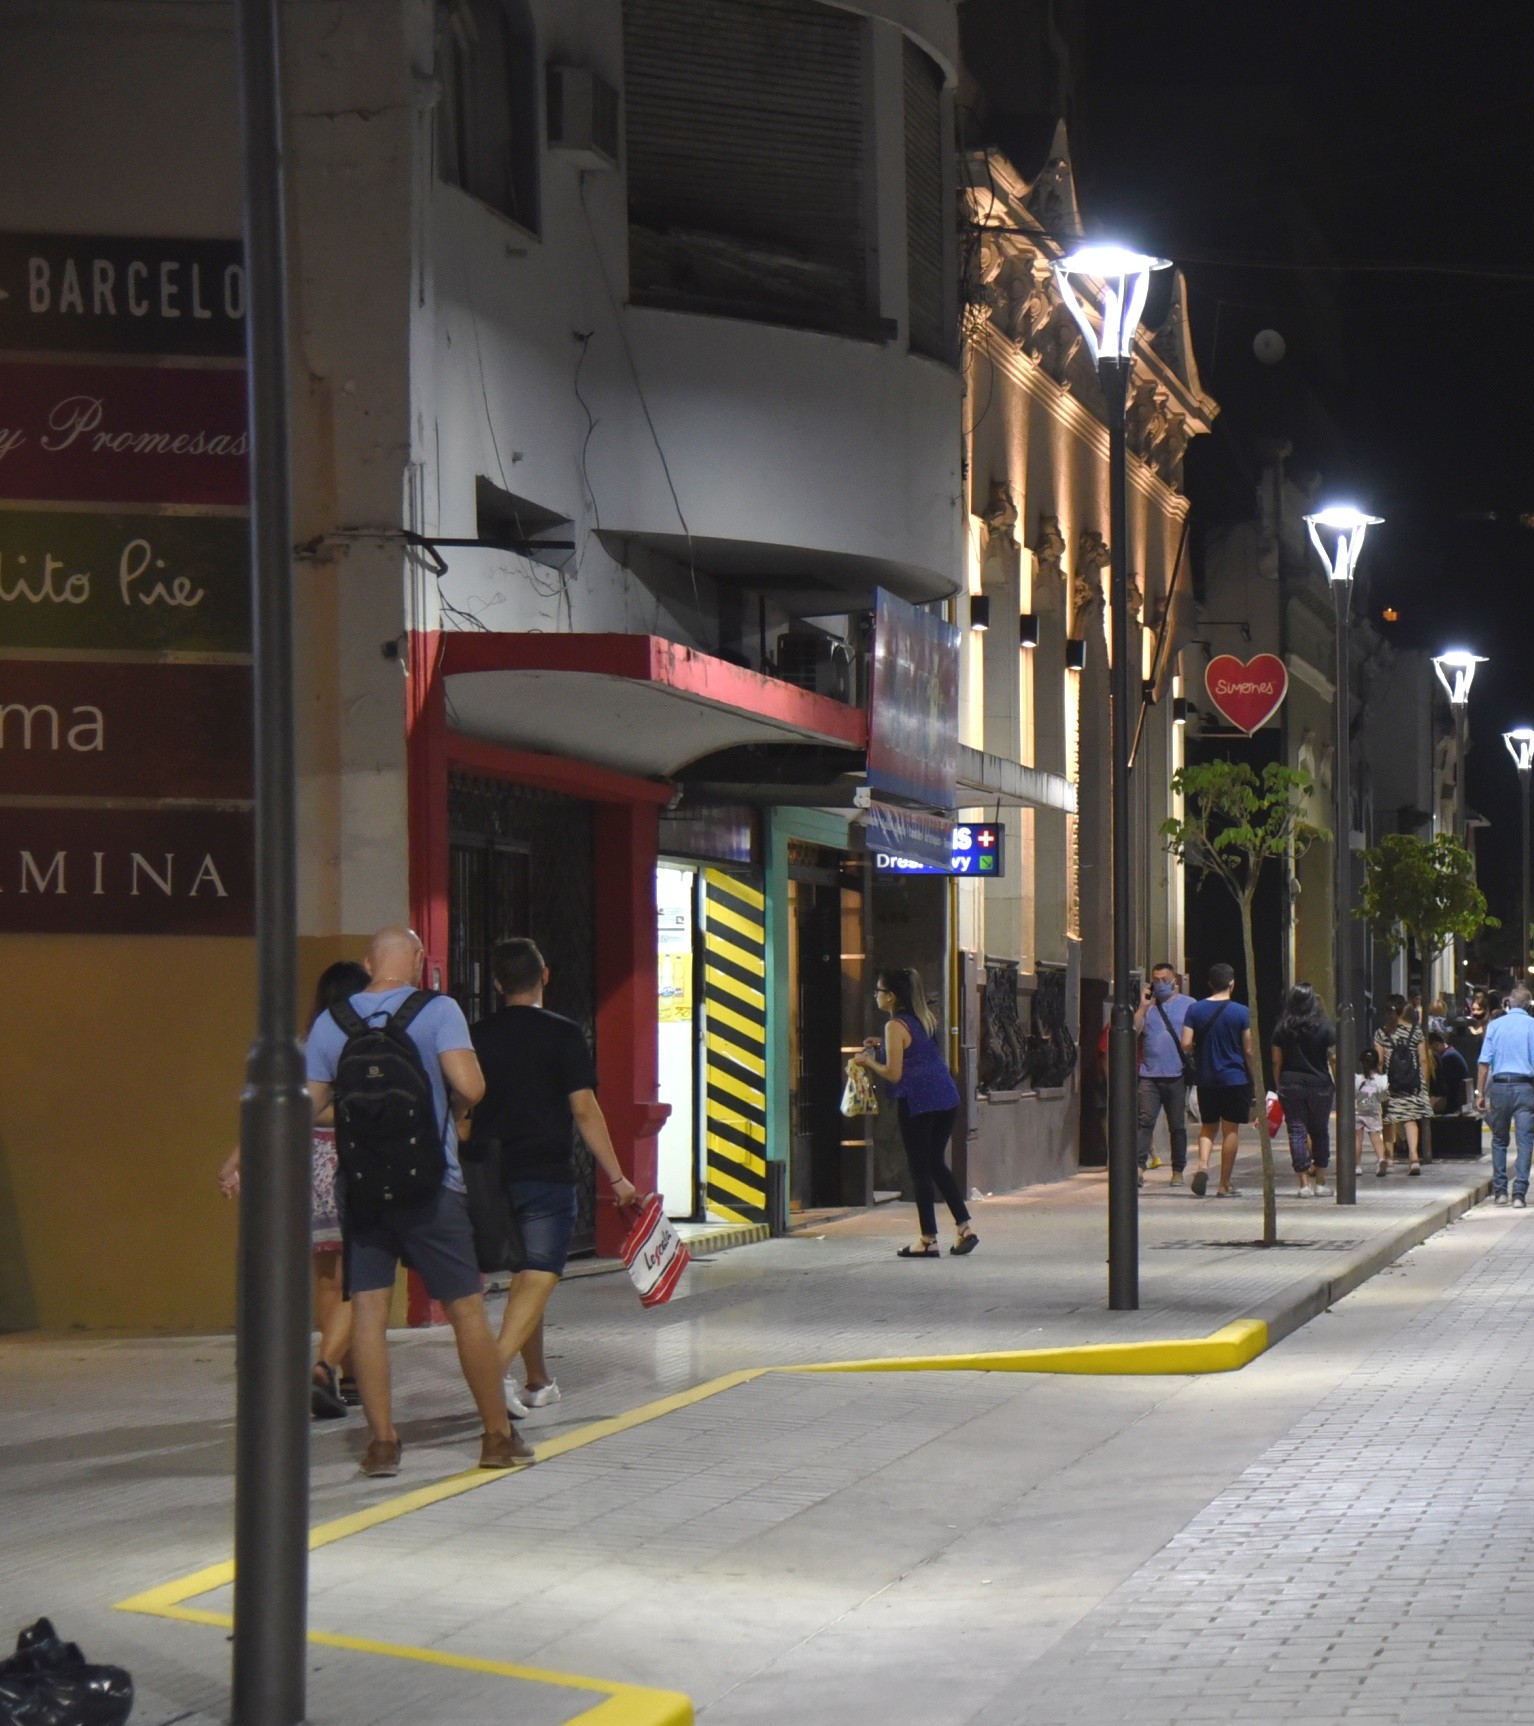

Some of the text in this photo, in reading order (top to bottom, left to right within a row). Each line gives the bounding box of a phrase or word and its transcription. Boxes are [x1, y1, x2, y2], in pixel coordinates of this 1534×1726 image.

[29, 256, 246, 319] BARCELO
[41, 395, 248, 456] Promesas
[0, 538, 205, 607] ito Pie
[0, 703, 104, 751] ma
[0, 850, 229, 897] MINA
